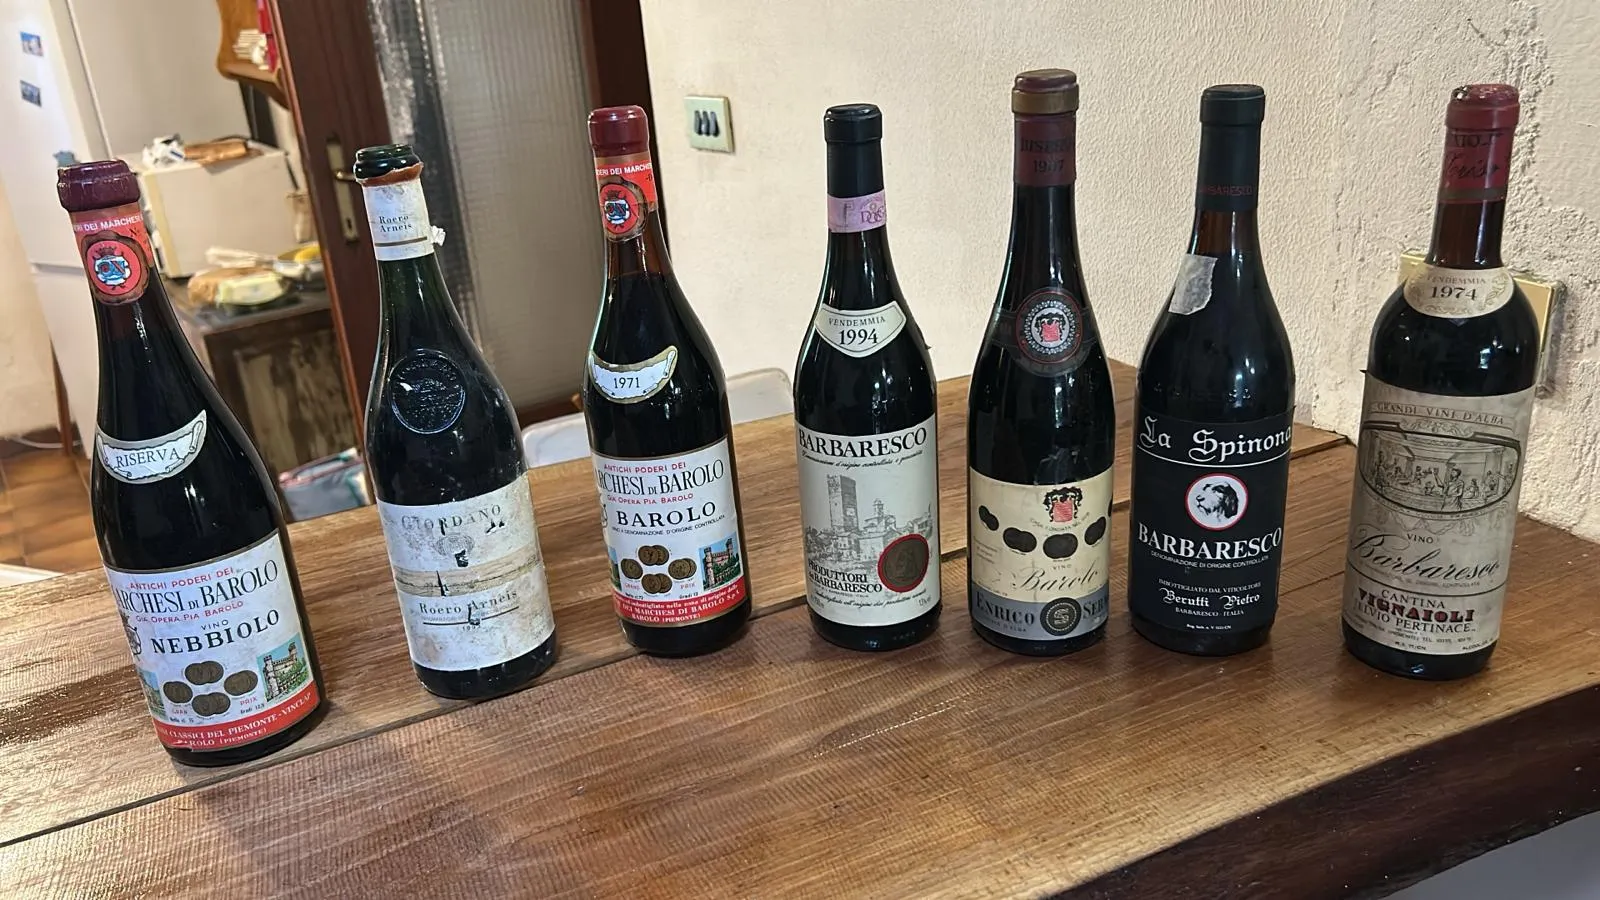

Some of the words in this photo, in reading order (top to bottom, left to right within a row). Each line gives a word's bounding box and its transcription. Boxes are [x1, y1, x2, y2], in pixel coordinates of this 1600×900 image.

[624, 162, 652, 174] MARCHE
[84, 223, 98, 231] DEI
[379, 214, 409, 224] Roero
[380, 223, 413, 234] Arneis
[1427, 275, 1486, 285] VENDEMMIA
[1429, 286, 1477, 301] 1974
[829, 315, 886, 327] VENDEMMIA
[839, 328, 879, 345] 1994
[613, 377, 640, 389] 1971
[1377, 402, 1417, 415] GRANDI
[1427, 407, 1456, 418] VINI
[799, 427, 927, 458] BARBARESCO
[1140, 415, 1172, 449] La
[1188, 426, 1292, 462] Spinona
[116, 447, 180, 469] RISERVA
[604, 464, 632, 473] ANTICHI
[635, 465, 668, 474] PODERI
[672, 461, 687, 470] DEI
[648, 486, 657, 495] DI
[658, 459, 724, 495] BAROLO
[660, 492, 694, 504] BAROLO
[401, 504, 502, 530] GIORDANO
[616, 501, 716, 527] BAROLO
[695, 514, 725, 529] CONTROLLATA
[1138, 522, 1282, 560] BARBARESCO
[1407, 533, 1434, 544] VINO
[1151, 550, 1198, 567] DENOMINAZIONE
[1352, 534, 1500, 581] Barbaresco
[130, 581, 167, 590] ANTICHI
[172, 575, 212, 588] PODERI
[216, 567, 234, 578] DEI
[808, 560, 867, 583] PRODUTTORI
[1020, 559, 1098, 591] Barolo
[112, 586, 185, 613] ARCHESI
[188, 599, 199, 610] DI
[200, 559, 278, 607] BAROLO
[815, 572, 883, 593] BARBARESCO
[419, 602, 462, 615] Roero
[468, 591, 518, 610] Arneis
[635, 608, 675, 616] MARCHESI
[691, 598, 725, 613] BAROLO
[976, 591, 1034, 625] ENRICO
[1219, 594, 1260, 609] Pietro
[1359, 587, 1475, 623] VIGNAIOLI
[1382, 589, 1445, 609] CANTINA
[151, 615, 180, 623] OPERA
[184, 613, 200, 621] PIA
[205, 600, 244, 617] BAROLO
[1175, 607, 1219, 617] BARBARESCO
[1223, 609, 1244, 617] ITALIA
[151, 609, 280, 654] NEBBIOLO
[201, 619, 229, 630] VINO
[1396, 617, 1471, 633] PERTINACE
[169, 729, 204, 739] CLASSICI
[207, 730, 225, 739] DEL
[228, 714, 277, 735] PIEMONTE
[188, 739, 215, 747] ROLO
[220, 727, 267, 744] (PIEMONTE)
